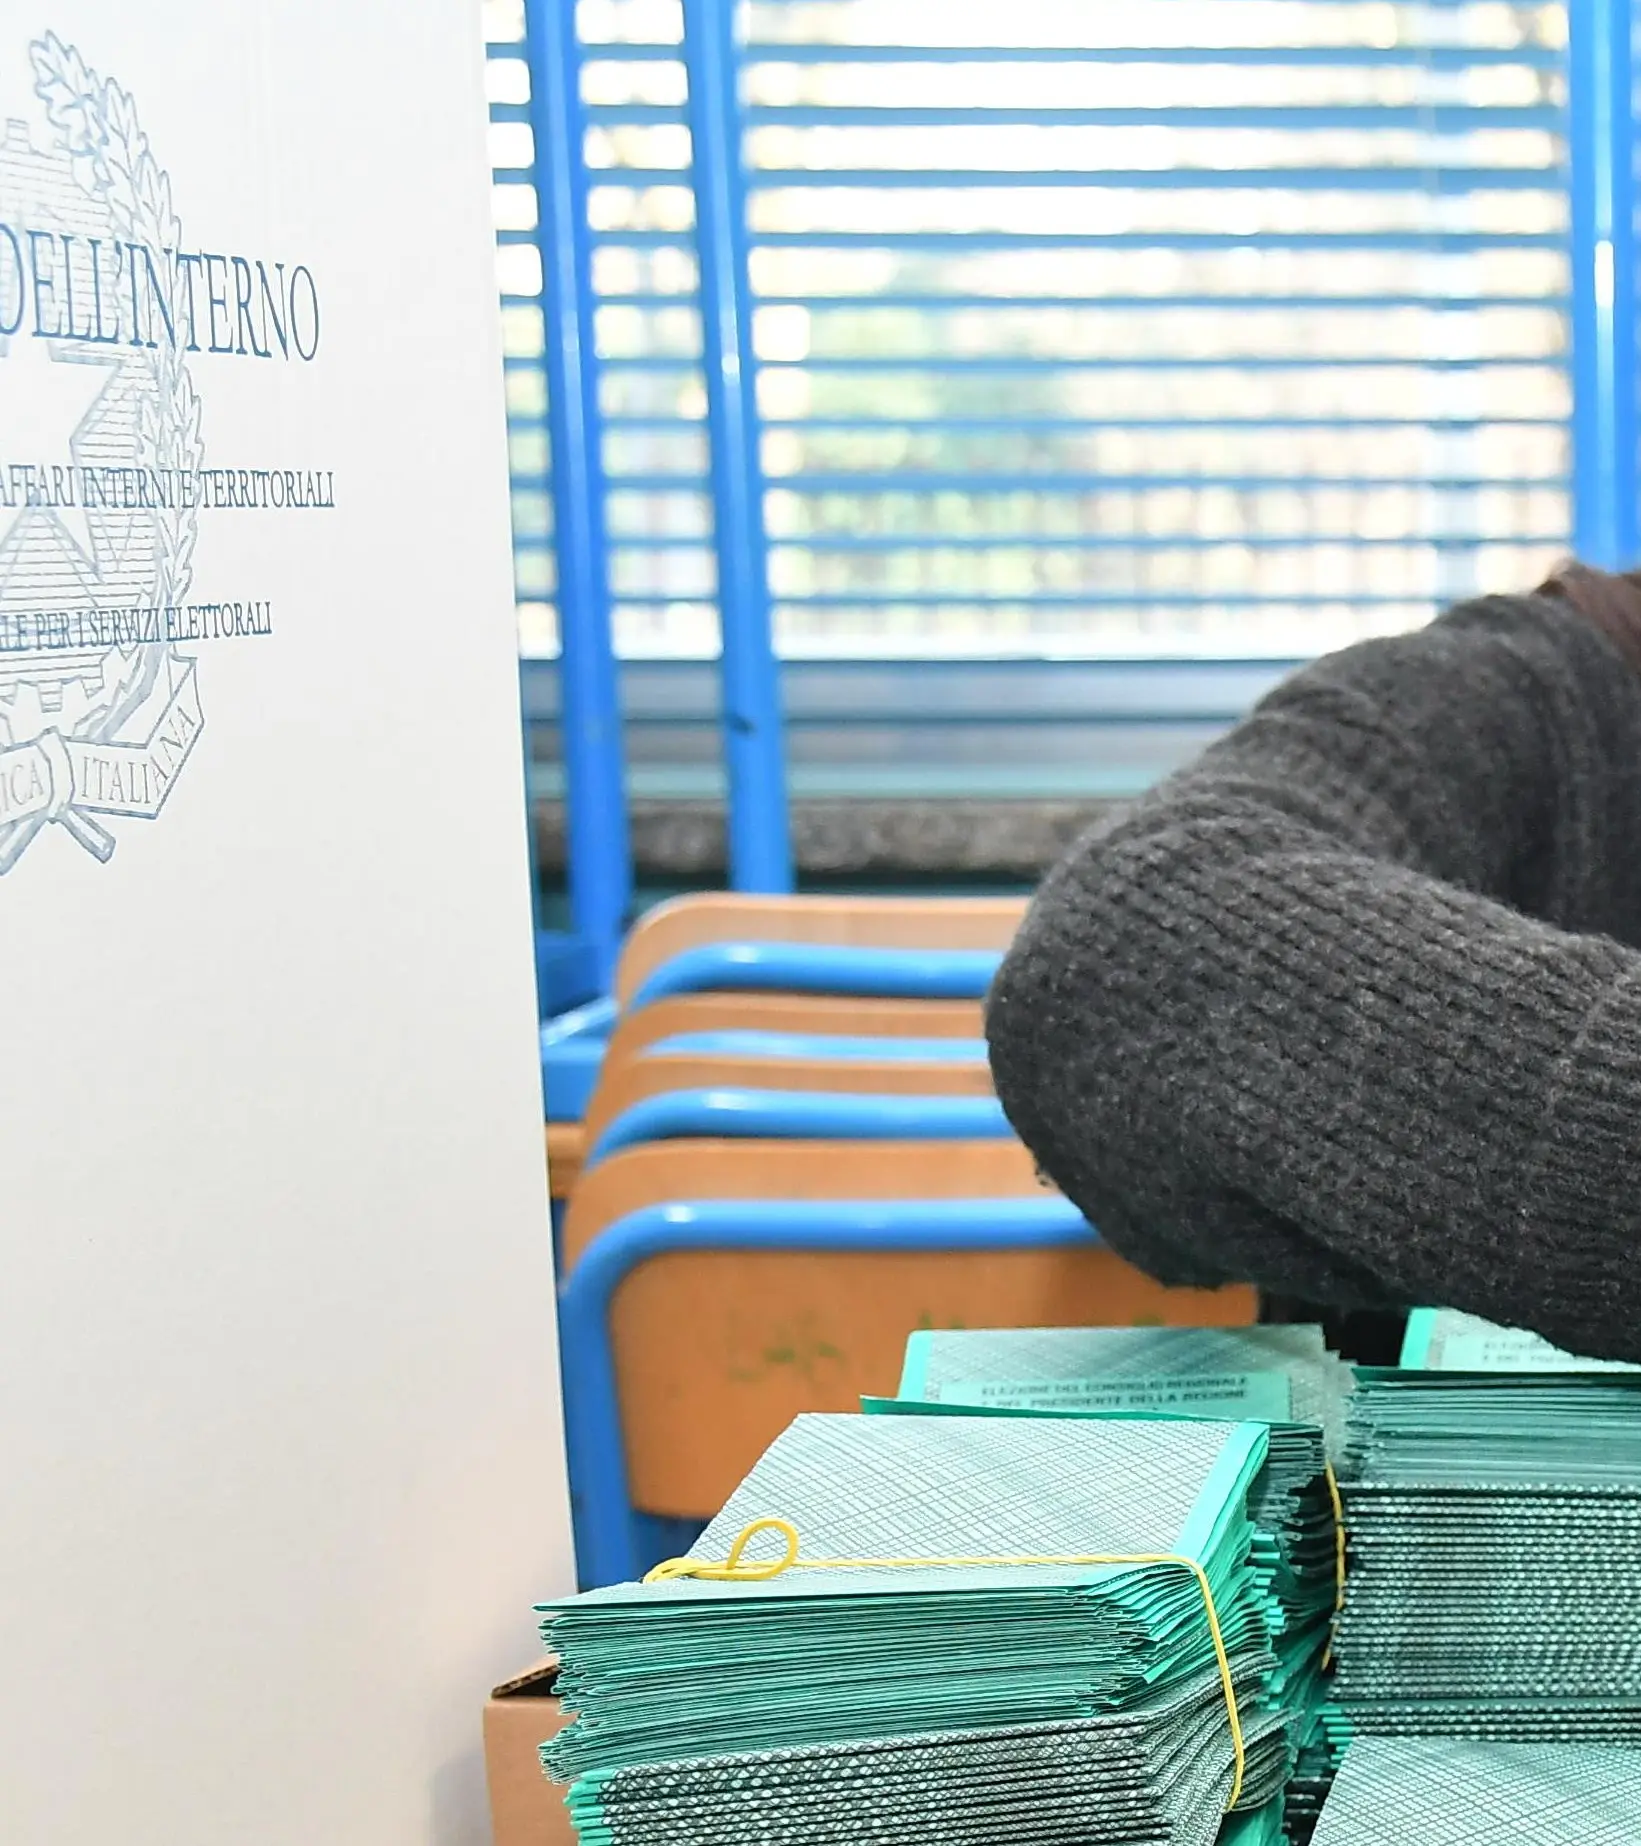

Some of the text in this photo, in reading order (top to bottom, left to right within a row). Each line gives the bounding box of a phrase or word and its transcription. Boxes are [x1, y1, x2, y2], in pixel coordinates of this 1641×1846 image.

[80, 466, 176, 509] INTERNI
[179, 469, 195, 509] E
[200, 469, 335, 508] TERRITORIALI
[34, 612, 73, 651] PER
[76, 611, 86, 648] I
[88, 607, 162, 646] SERVIZI
[164, 601, 272, 642] ELETTORALI
[82, 704, 196, 805] ITALIANA
